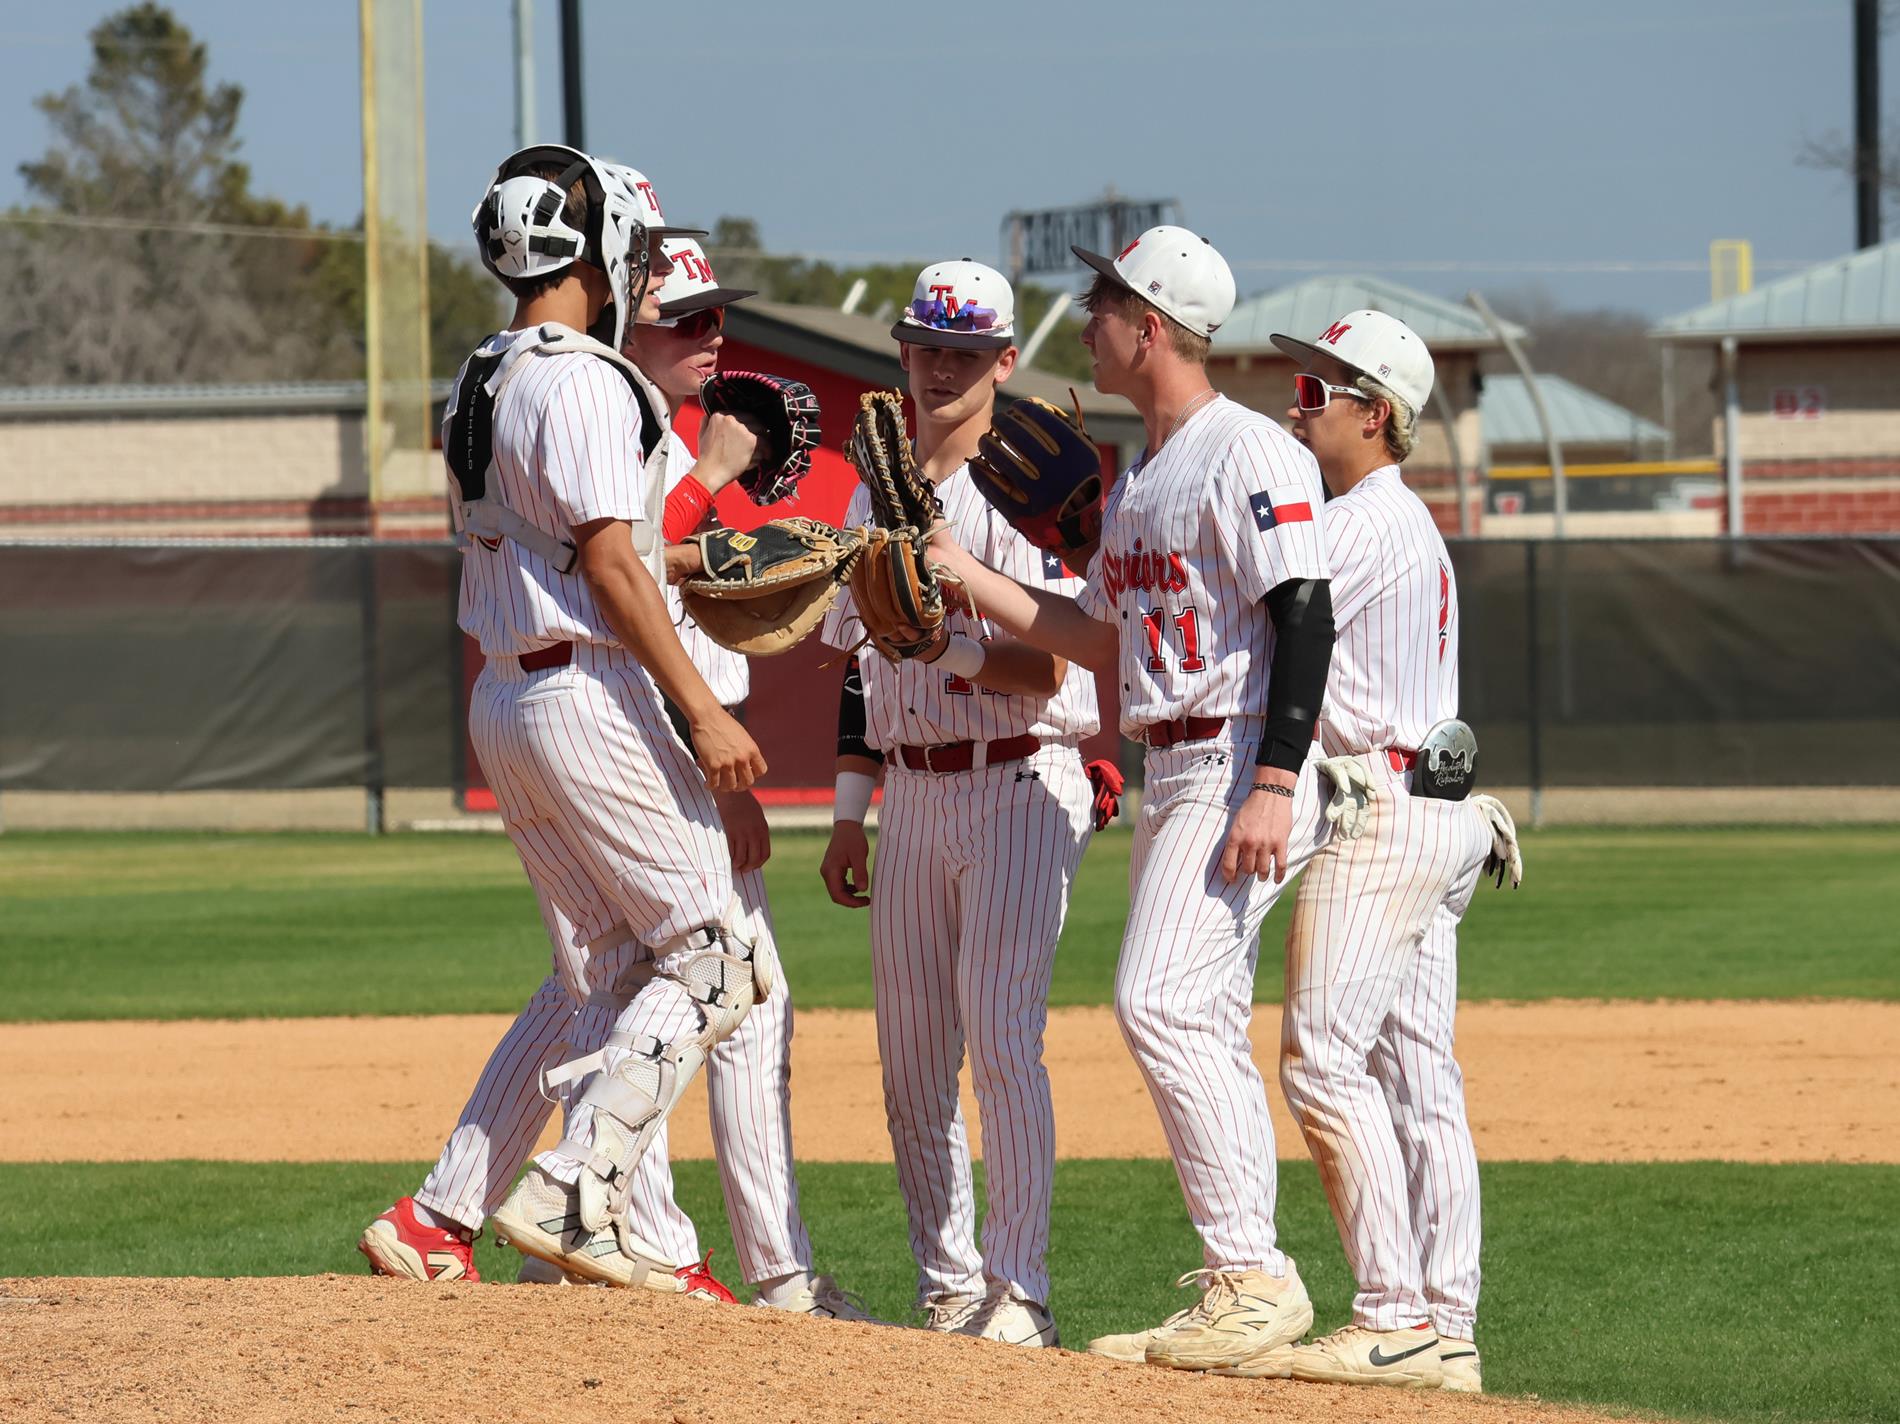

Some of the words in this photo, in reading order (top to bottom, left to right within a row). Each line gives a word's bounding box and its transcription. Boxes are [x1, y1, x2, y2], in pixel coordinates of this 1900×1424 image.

[636, 181, 664, 218] T
[670, 249, 717, 283] TM
[1141, 605, 1206, 673] 11
